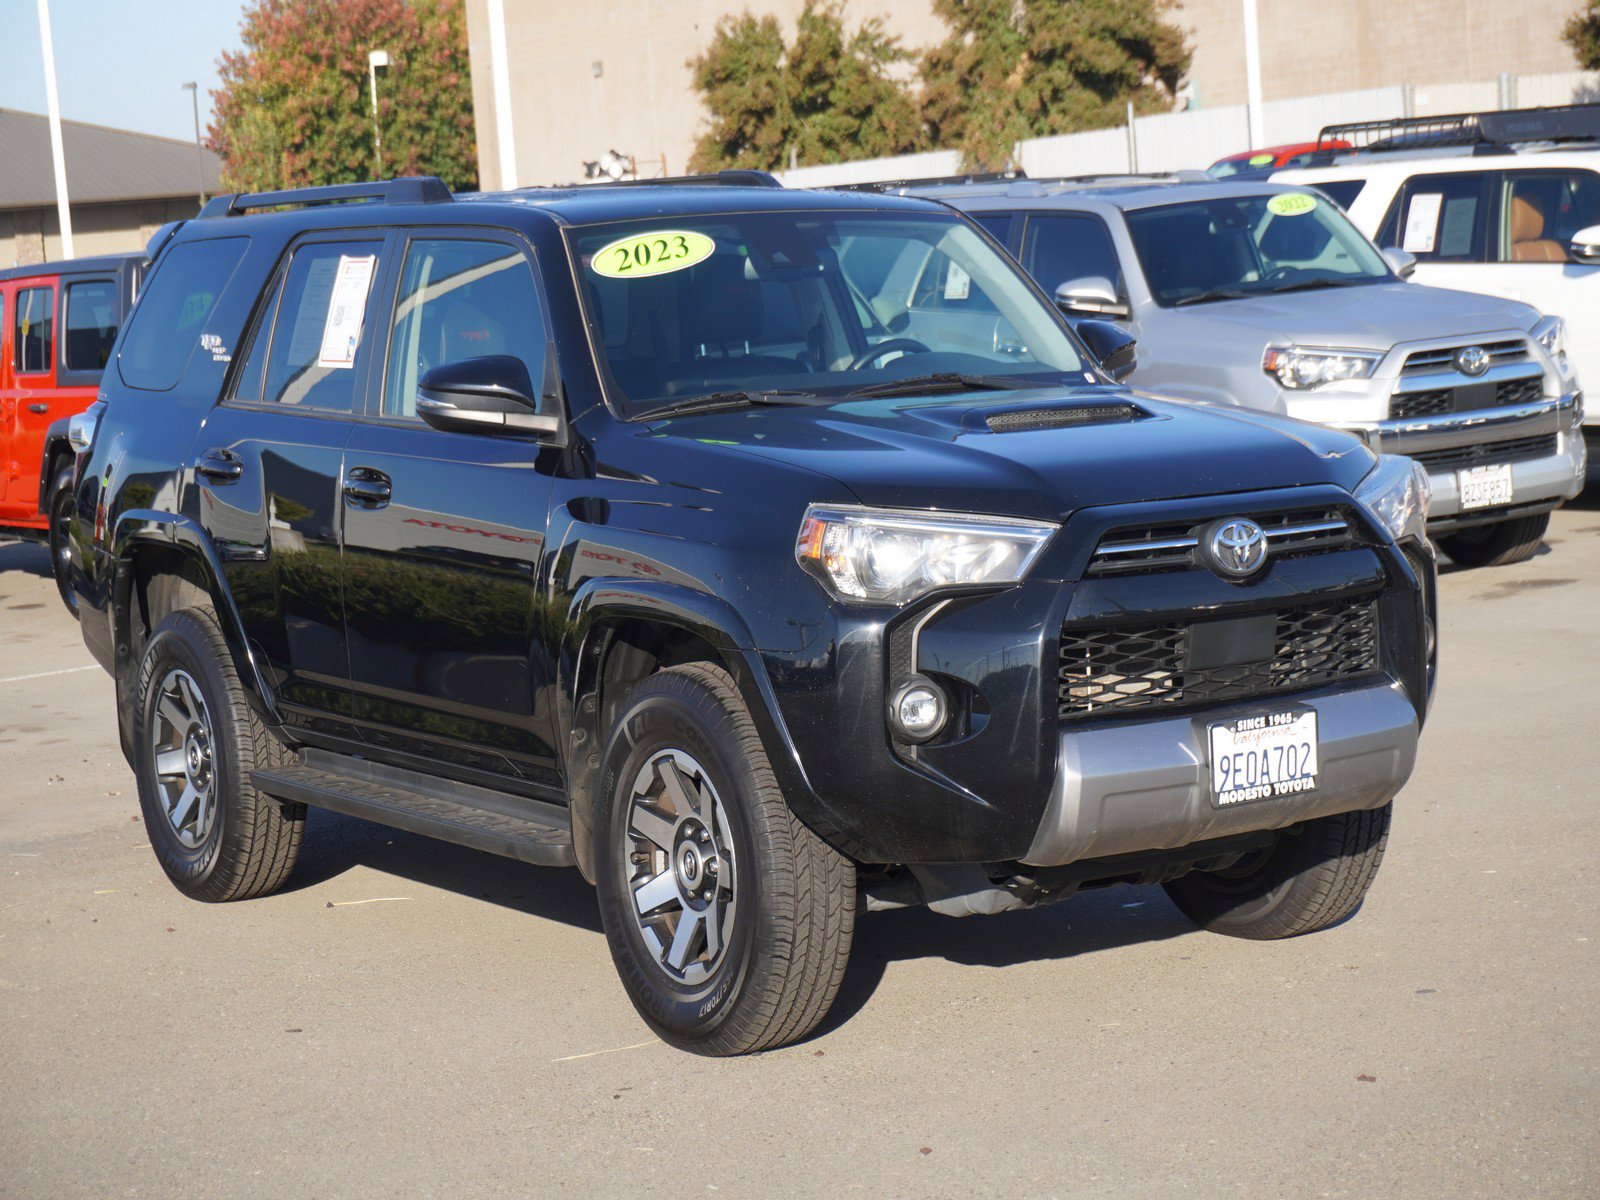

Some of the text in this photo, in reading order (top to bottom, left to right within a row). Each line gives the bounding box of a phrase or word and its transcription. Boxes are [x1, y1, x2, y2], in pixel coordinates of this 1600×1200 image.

[614, 236, 689, 272] 2023
[1236, 712, 1293, 731] SINCE 1965
[1232, 726, 1297, 746] California
[1219, 776, 1315, 804] MODESTO TOYOTA
